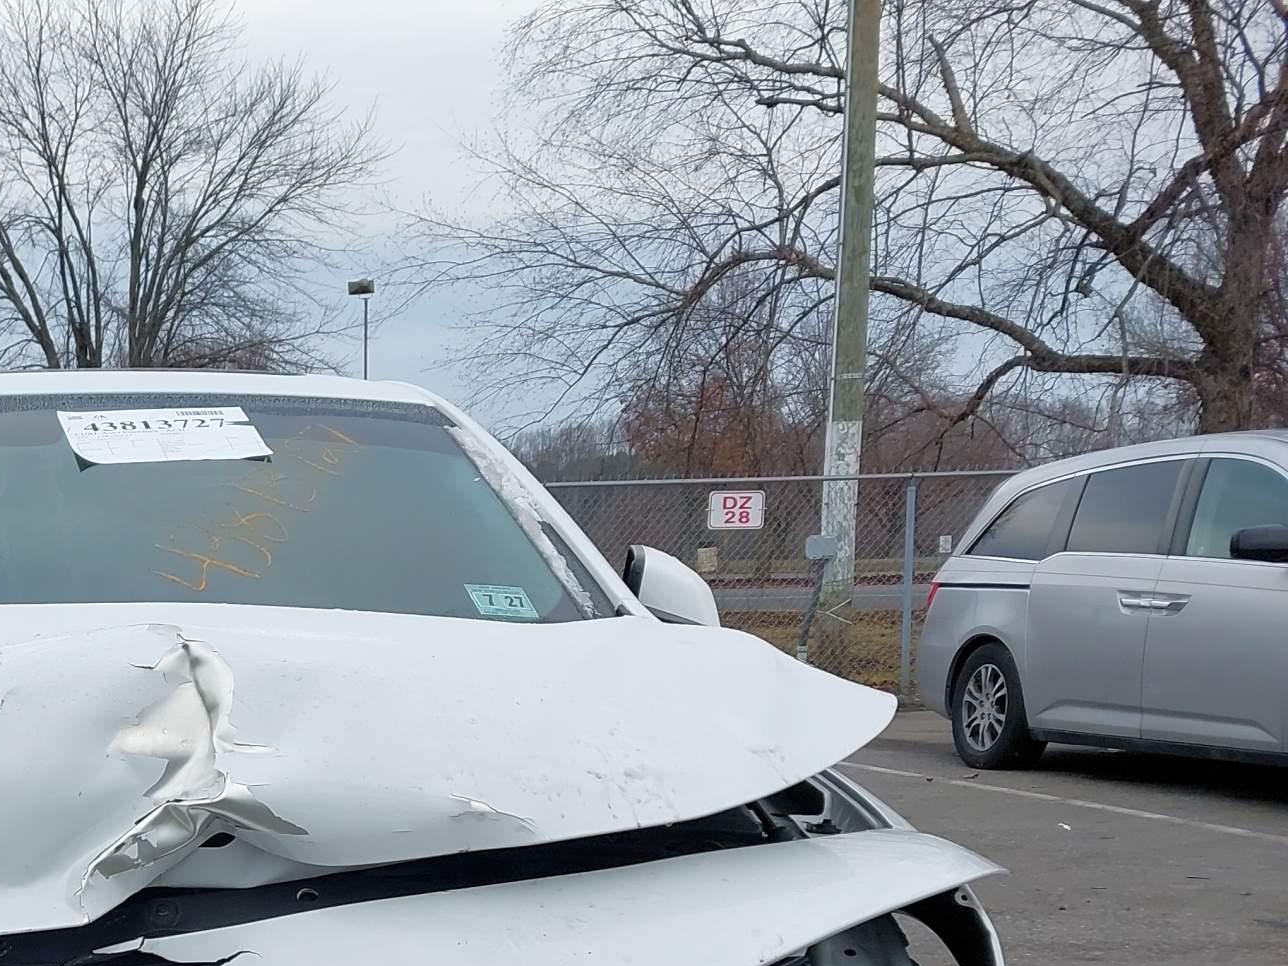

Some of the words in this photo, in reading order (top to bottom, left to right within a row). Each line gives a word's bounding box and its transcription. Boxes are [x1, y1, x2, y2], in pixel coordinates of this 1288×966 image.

[83, 418, 224, 432] 43813727
[723, 496, 752, 510] DZ
[724, 510, 750, 524] 28
[482, 594, 495, 606] 7
[504, 595, 524, 608] 27
